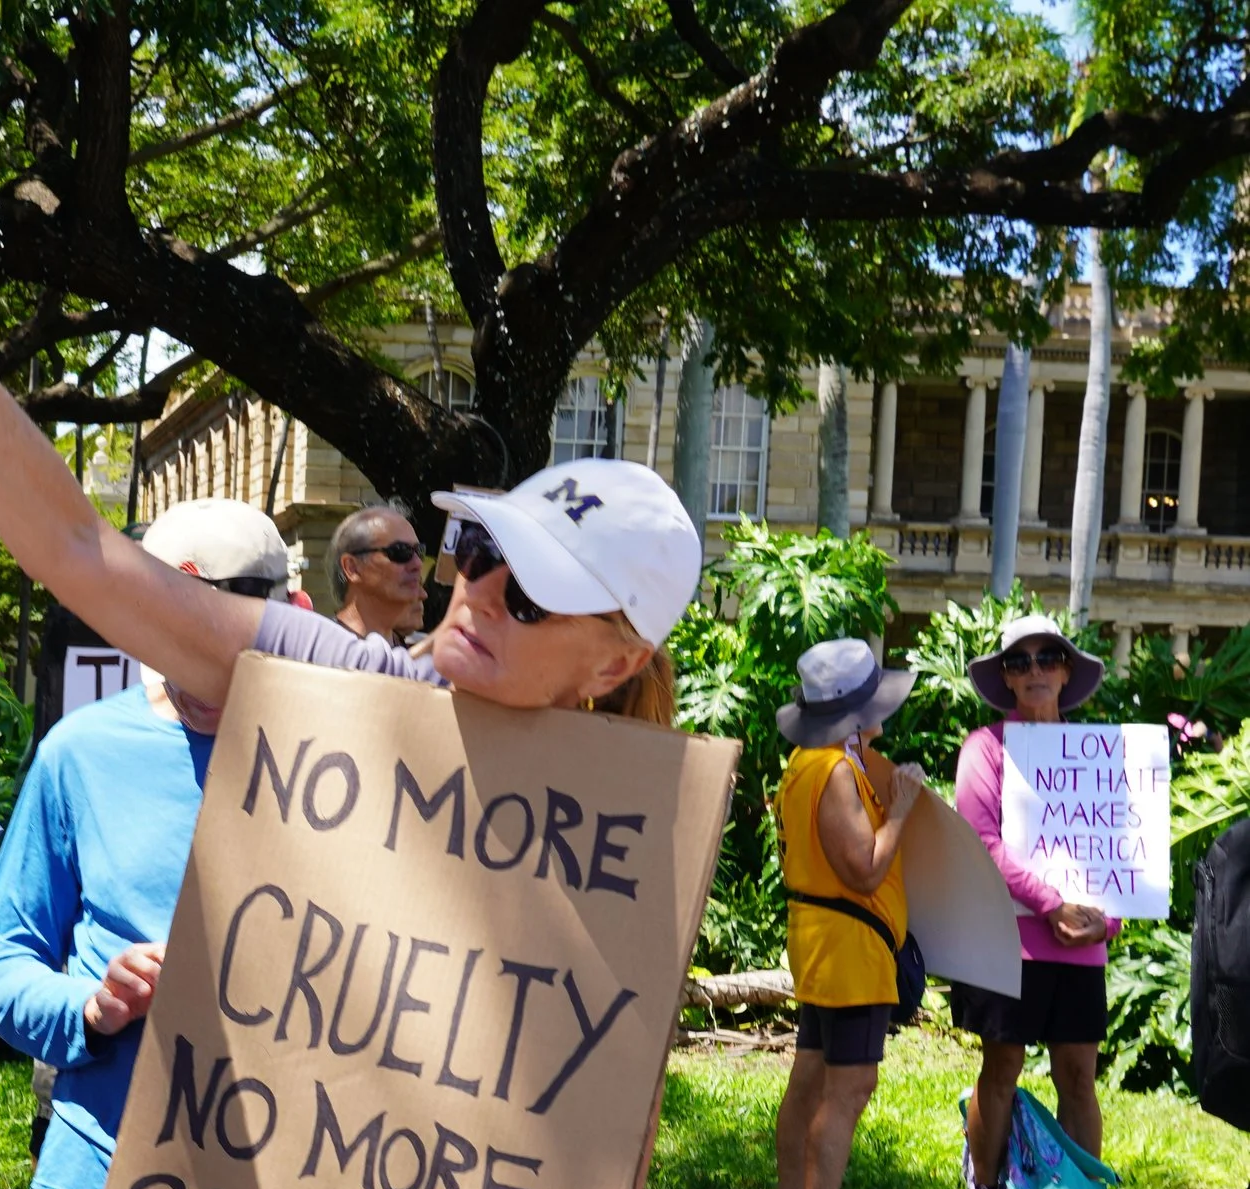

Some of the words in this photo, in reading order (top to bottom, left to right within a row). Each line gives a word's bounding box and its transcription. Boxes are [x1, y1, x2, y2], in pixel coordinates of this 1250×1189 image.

[543, 477, 604, 528] M
[1036, 766, 1087, 793] NOT
[241, 725, 360, 833] NO
[384, 757, 648, 901] MORE
[1041, 801, 1142, 829] MAKES
[1030, 834, 1147, 861] AMERICA
[218, 883, 638, 1115] CRUELTY
[154, 1034, 278, 1161] NO
